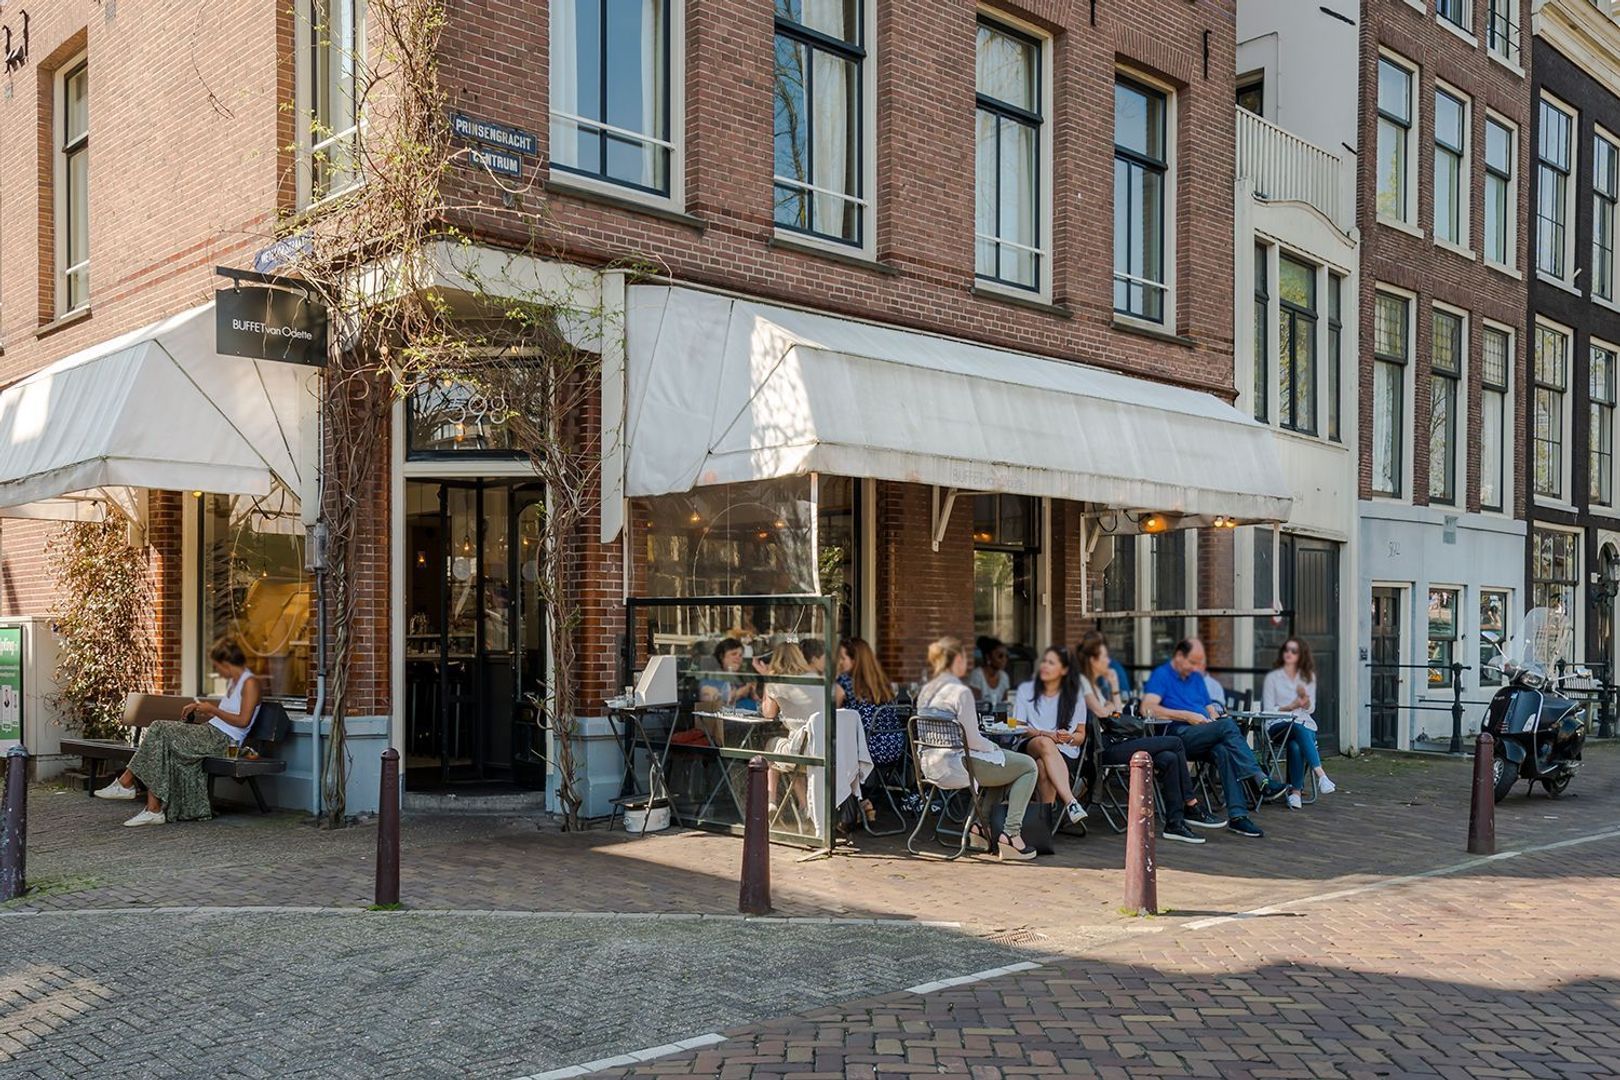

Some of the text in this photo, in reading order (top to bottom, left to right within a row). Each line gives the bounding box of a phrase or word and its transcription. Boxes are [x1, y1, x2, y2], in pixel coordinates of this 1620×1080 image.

[455, 118, 532, 150] PRINSENGRACHT
[232, 318, 313, 341] BUFFET van Odette
[447, 393, 507, 424] 598
